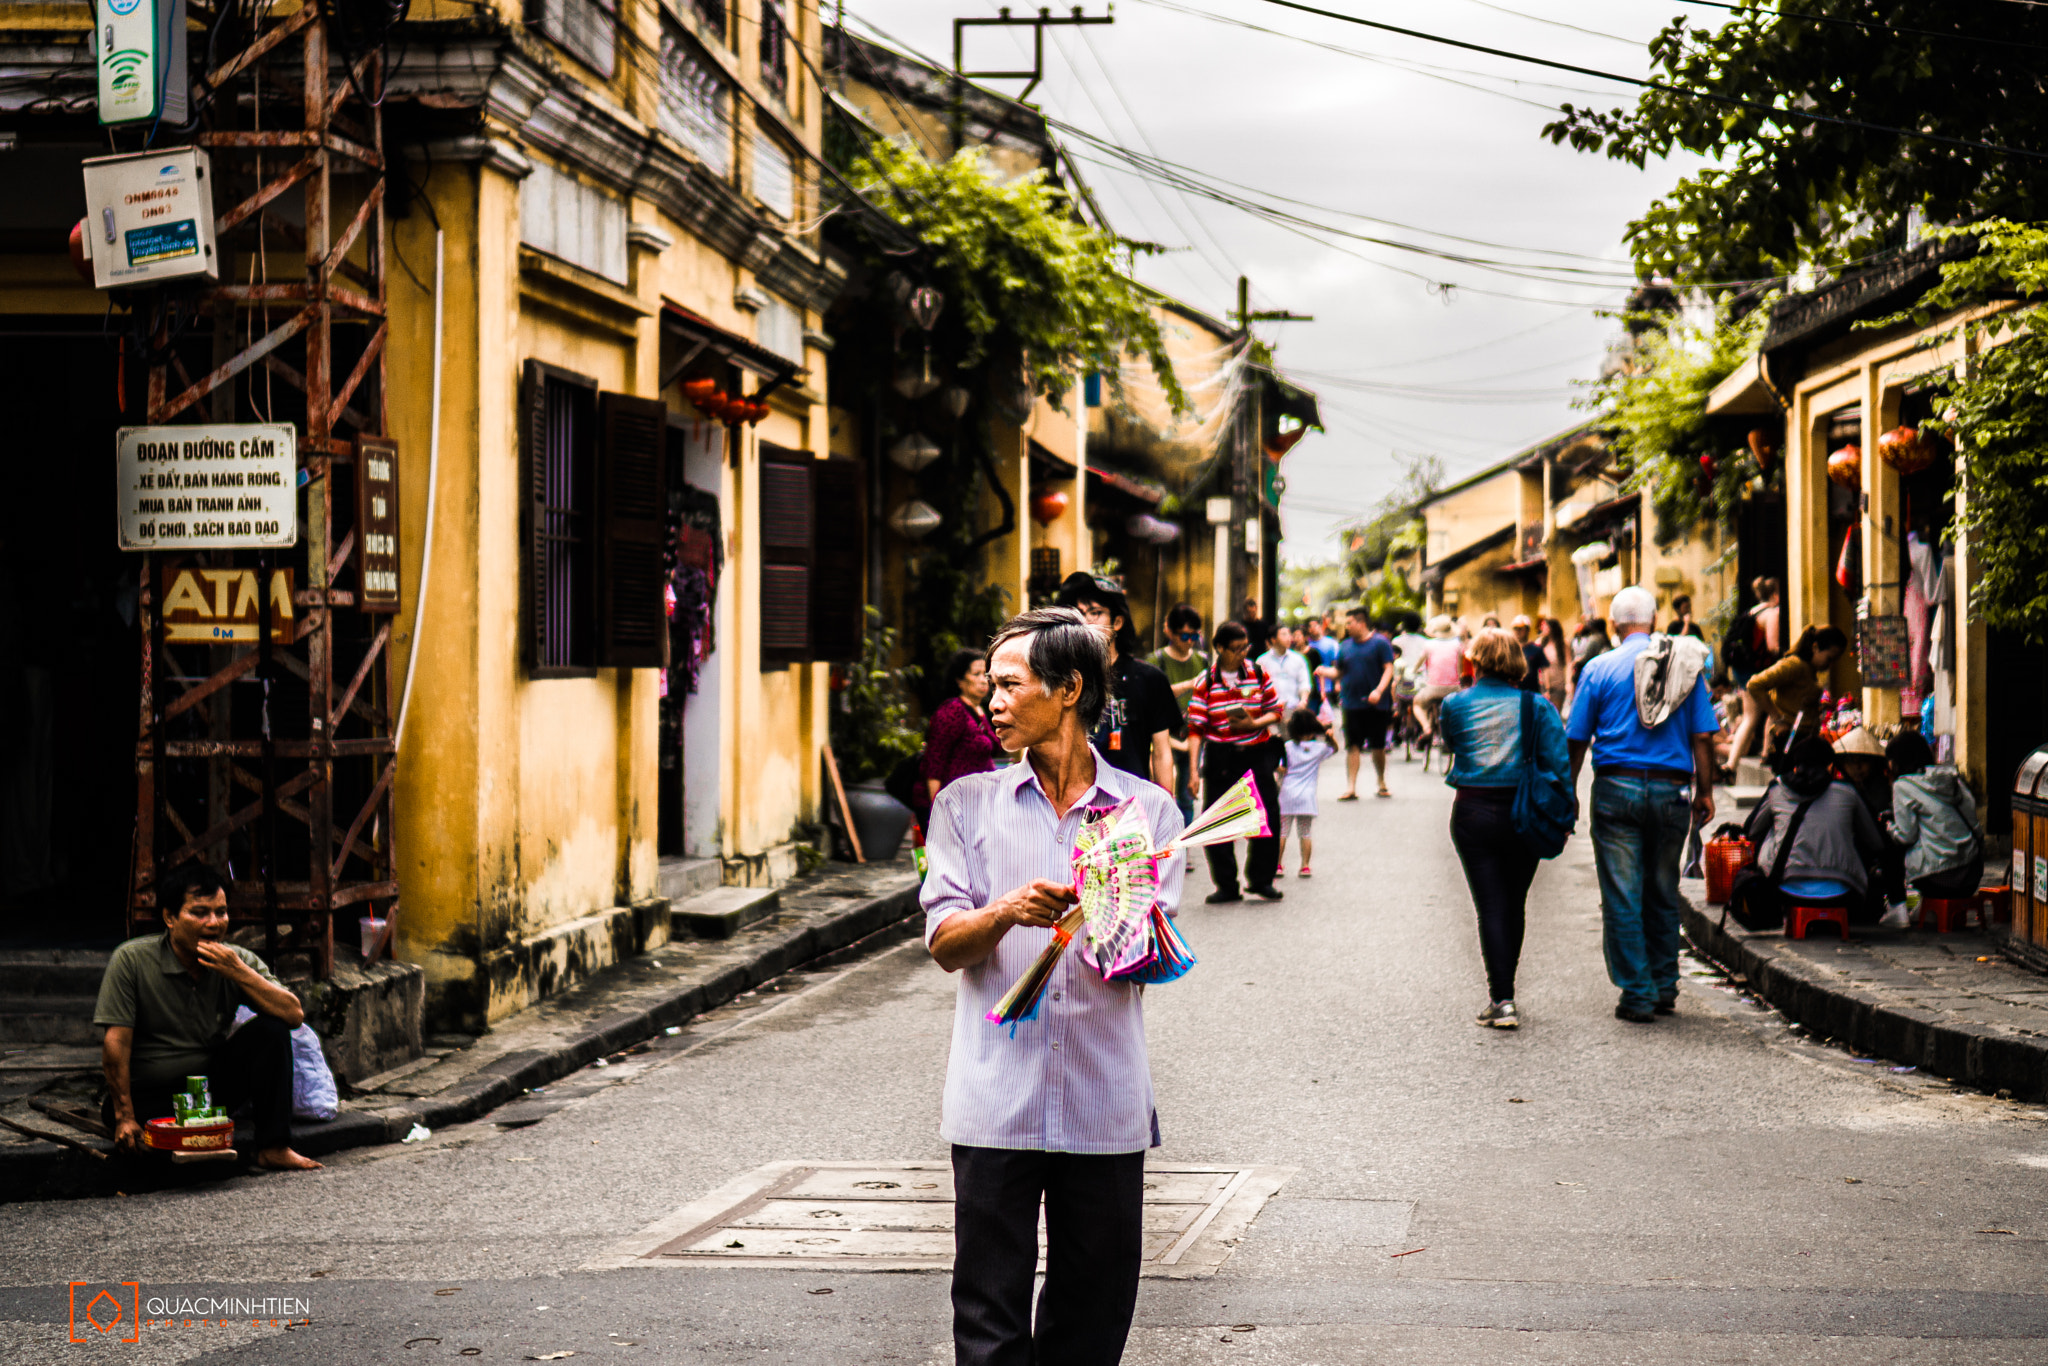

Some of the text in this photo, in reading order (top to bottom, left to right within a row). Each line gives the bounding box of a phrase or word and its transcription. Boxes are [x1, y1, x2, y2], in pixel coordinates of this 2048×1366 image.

[139, 497, 165, 514] MUA
[196, 496, 234, 513] TRANH
[162, 569, 293, 618] ATM
